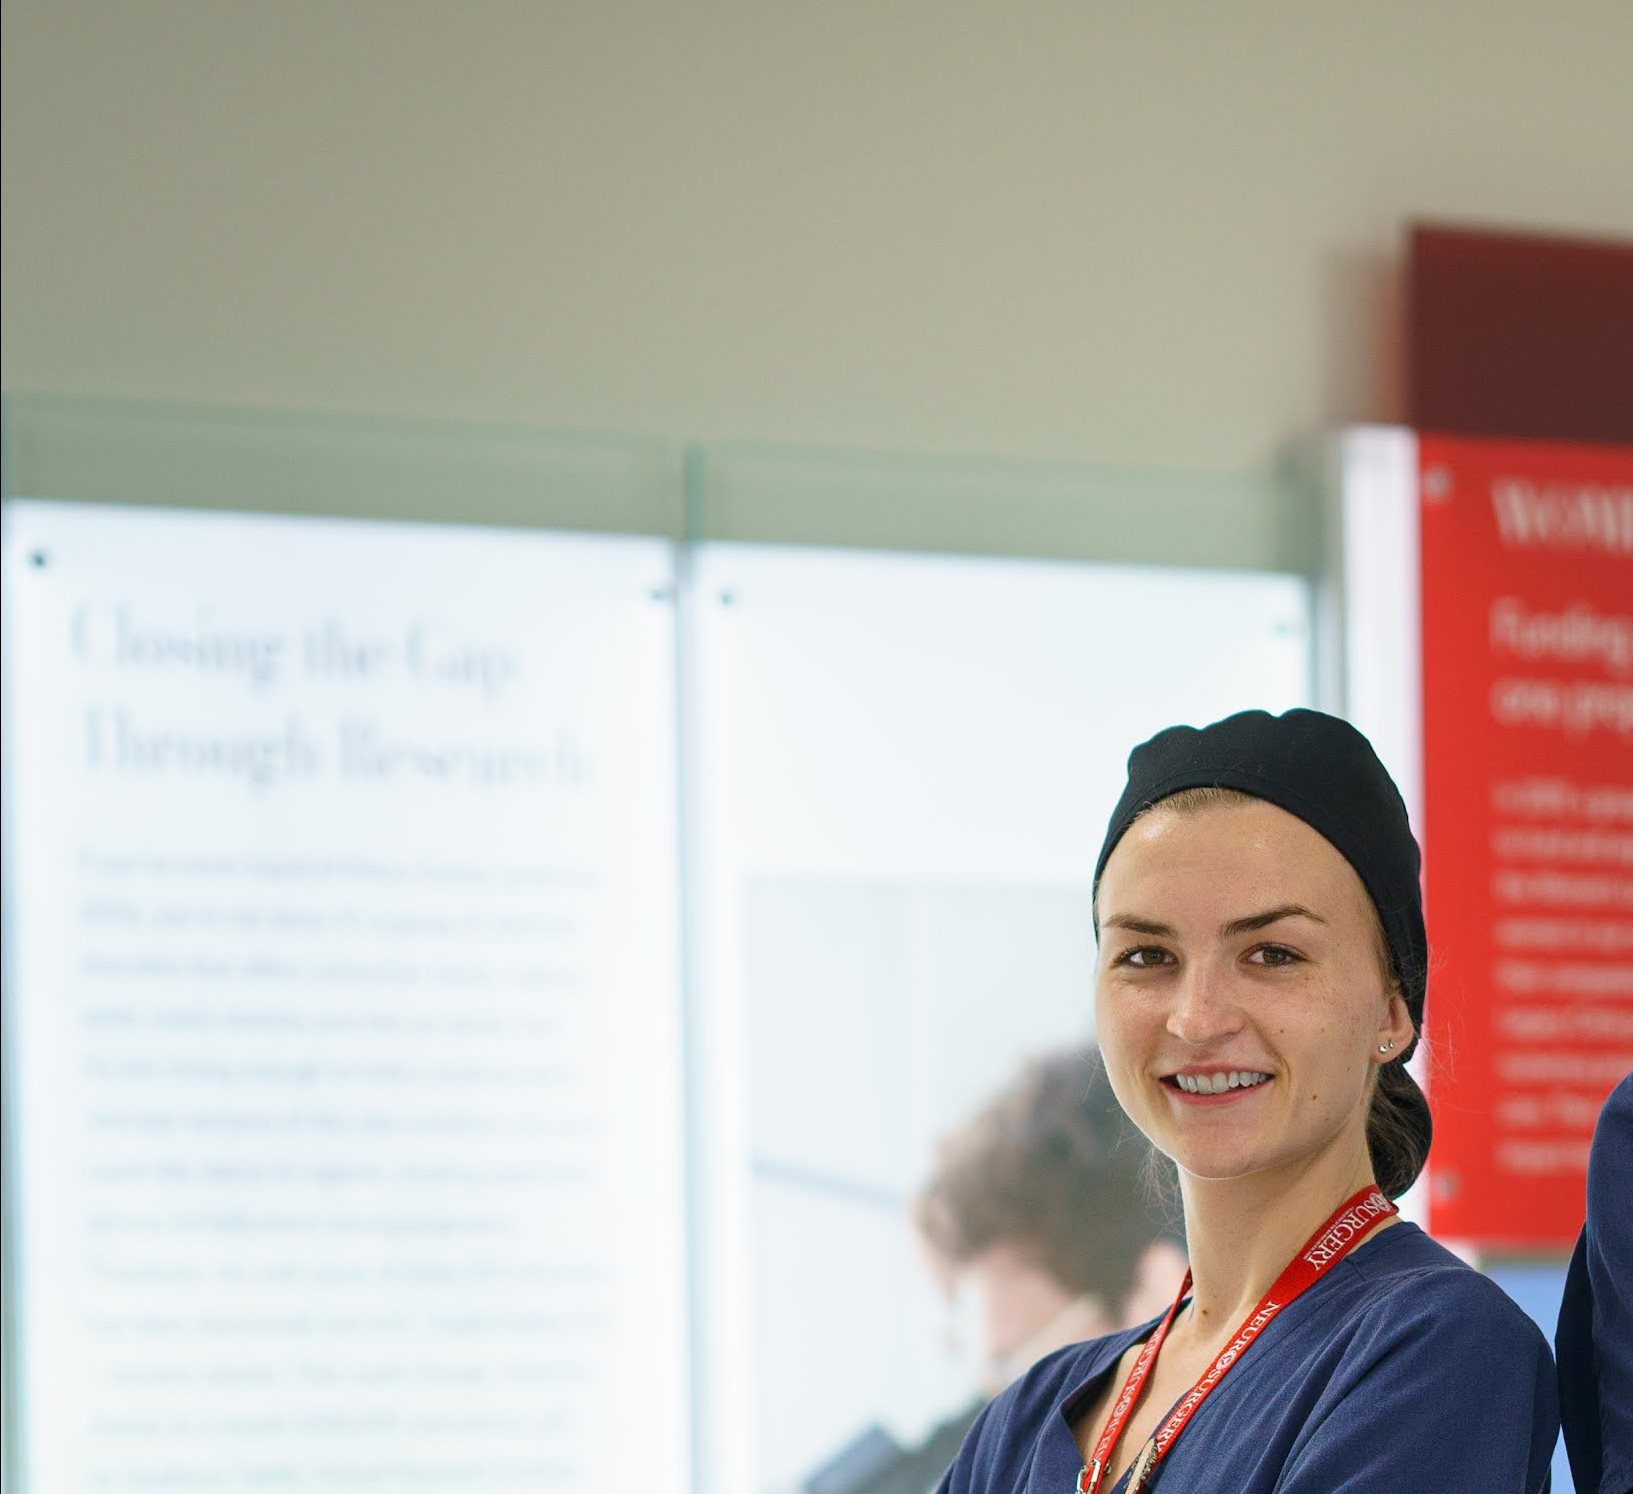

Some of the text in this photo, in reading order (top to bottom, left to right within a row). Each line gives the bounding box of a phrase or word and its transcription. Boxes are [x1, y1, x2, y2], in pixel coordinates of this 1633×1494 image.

[70, 600, 519, 696] Closing the Gap
[82, 706, 590, 791] Through Research
